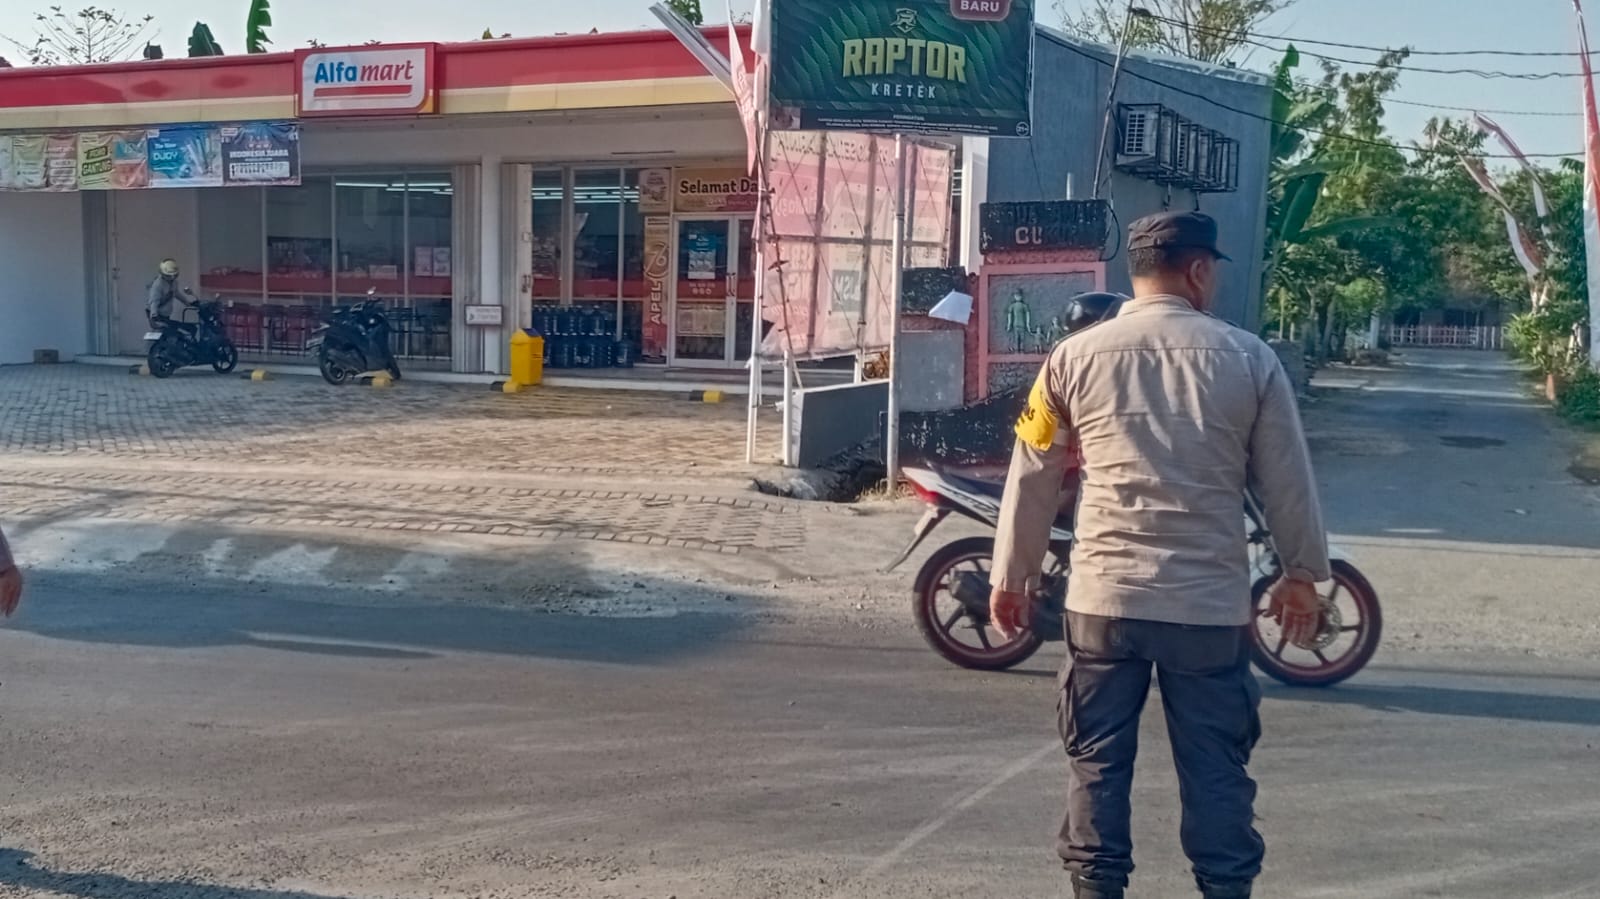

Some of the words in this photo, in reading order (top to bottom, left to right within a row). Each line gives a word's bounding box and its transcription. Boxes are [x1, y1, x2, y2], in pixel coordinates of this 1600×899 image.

[960, 0, 1000, 12] BARU
[842, 37, 967, 84] RAPTOR
[871, 83, 937, 98] KRETEK
[680, 180, 737, 193] Selamat
[740, 178, 759, 193] Da
[651, 279, 662, 325] APEL
